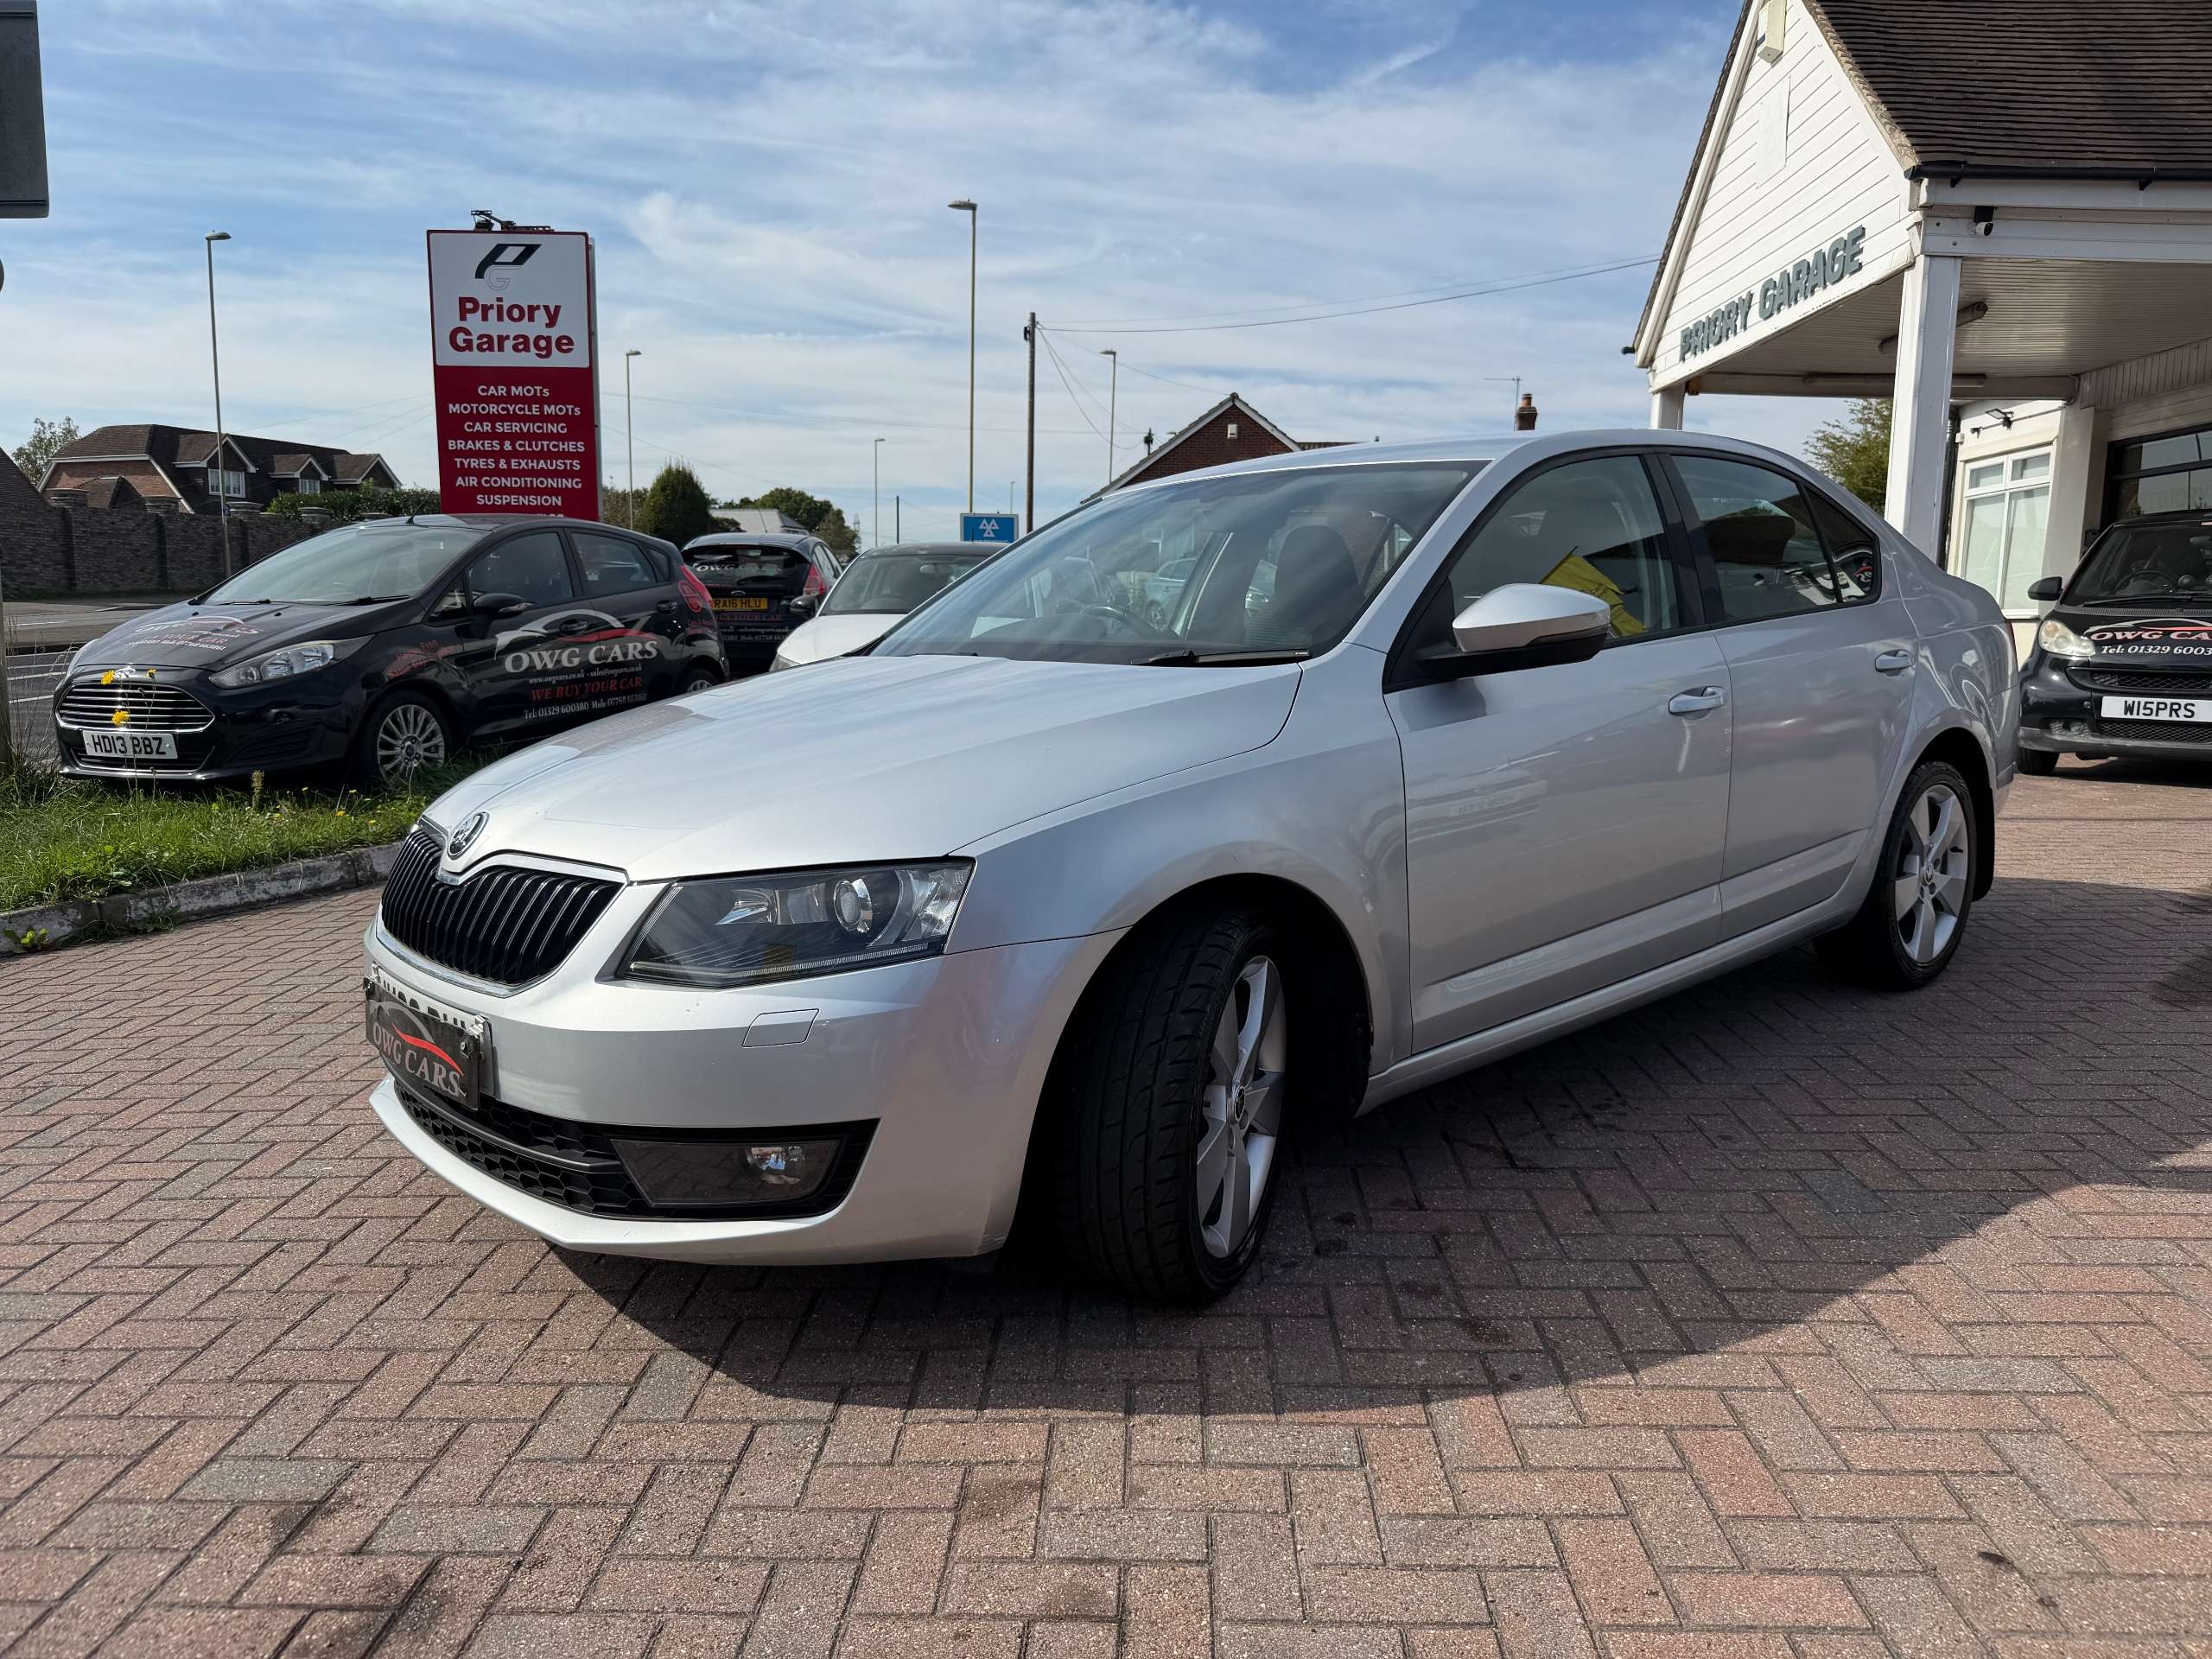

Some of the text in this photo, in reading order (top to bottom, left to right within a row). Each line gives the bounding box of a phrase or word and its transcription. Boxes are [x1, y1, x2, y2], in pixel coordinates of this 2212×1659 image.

[1679, 224, 1866, 363] PRIORY GARAGE
[458, 296, 562, 328] Priory
[448, 326, 575, 359] Garage
[478, 385, 550, 397] CAR MOTs
[448, 403, 581, 416] MOTORCYCLE MOTs
[464, 422, 568, 434] CAR SERVICING
[448, 440, 585, 453] BRAKES & CLUTCHES
[454, 458, 581, 471] TYRES & EXHAUSTS
[455, 476, 582, 489] AIR CONDITIONING
[476, 494, 562, 506] SUSPENSION
[2090, 631, 2212, 640] OWG CA
[505, 640, 658, 673] OWG CARS
[2101, 645, 2212, 656] Tel: 01329 6003
[531, 677, 643, 701] WE BUY YOUR CAR
[538, 706, 560, 717] 01329
[561, 701, 589, 714] 600380
[92, 734, 128, 754] HD13
[372, 1022, 461, 1096] OWG CARS
